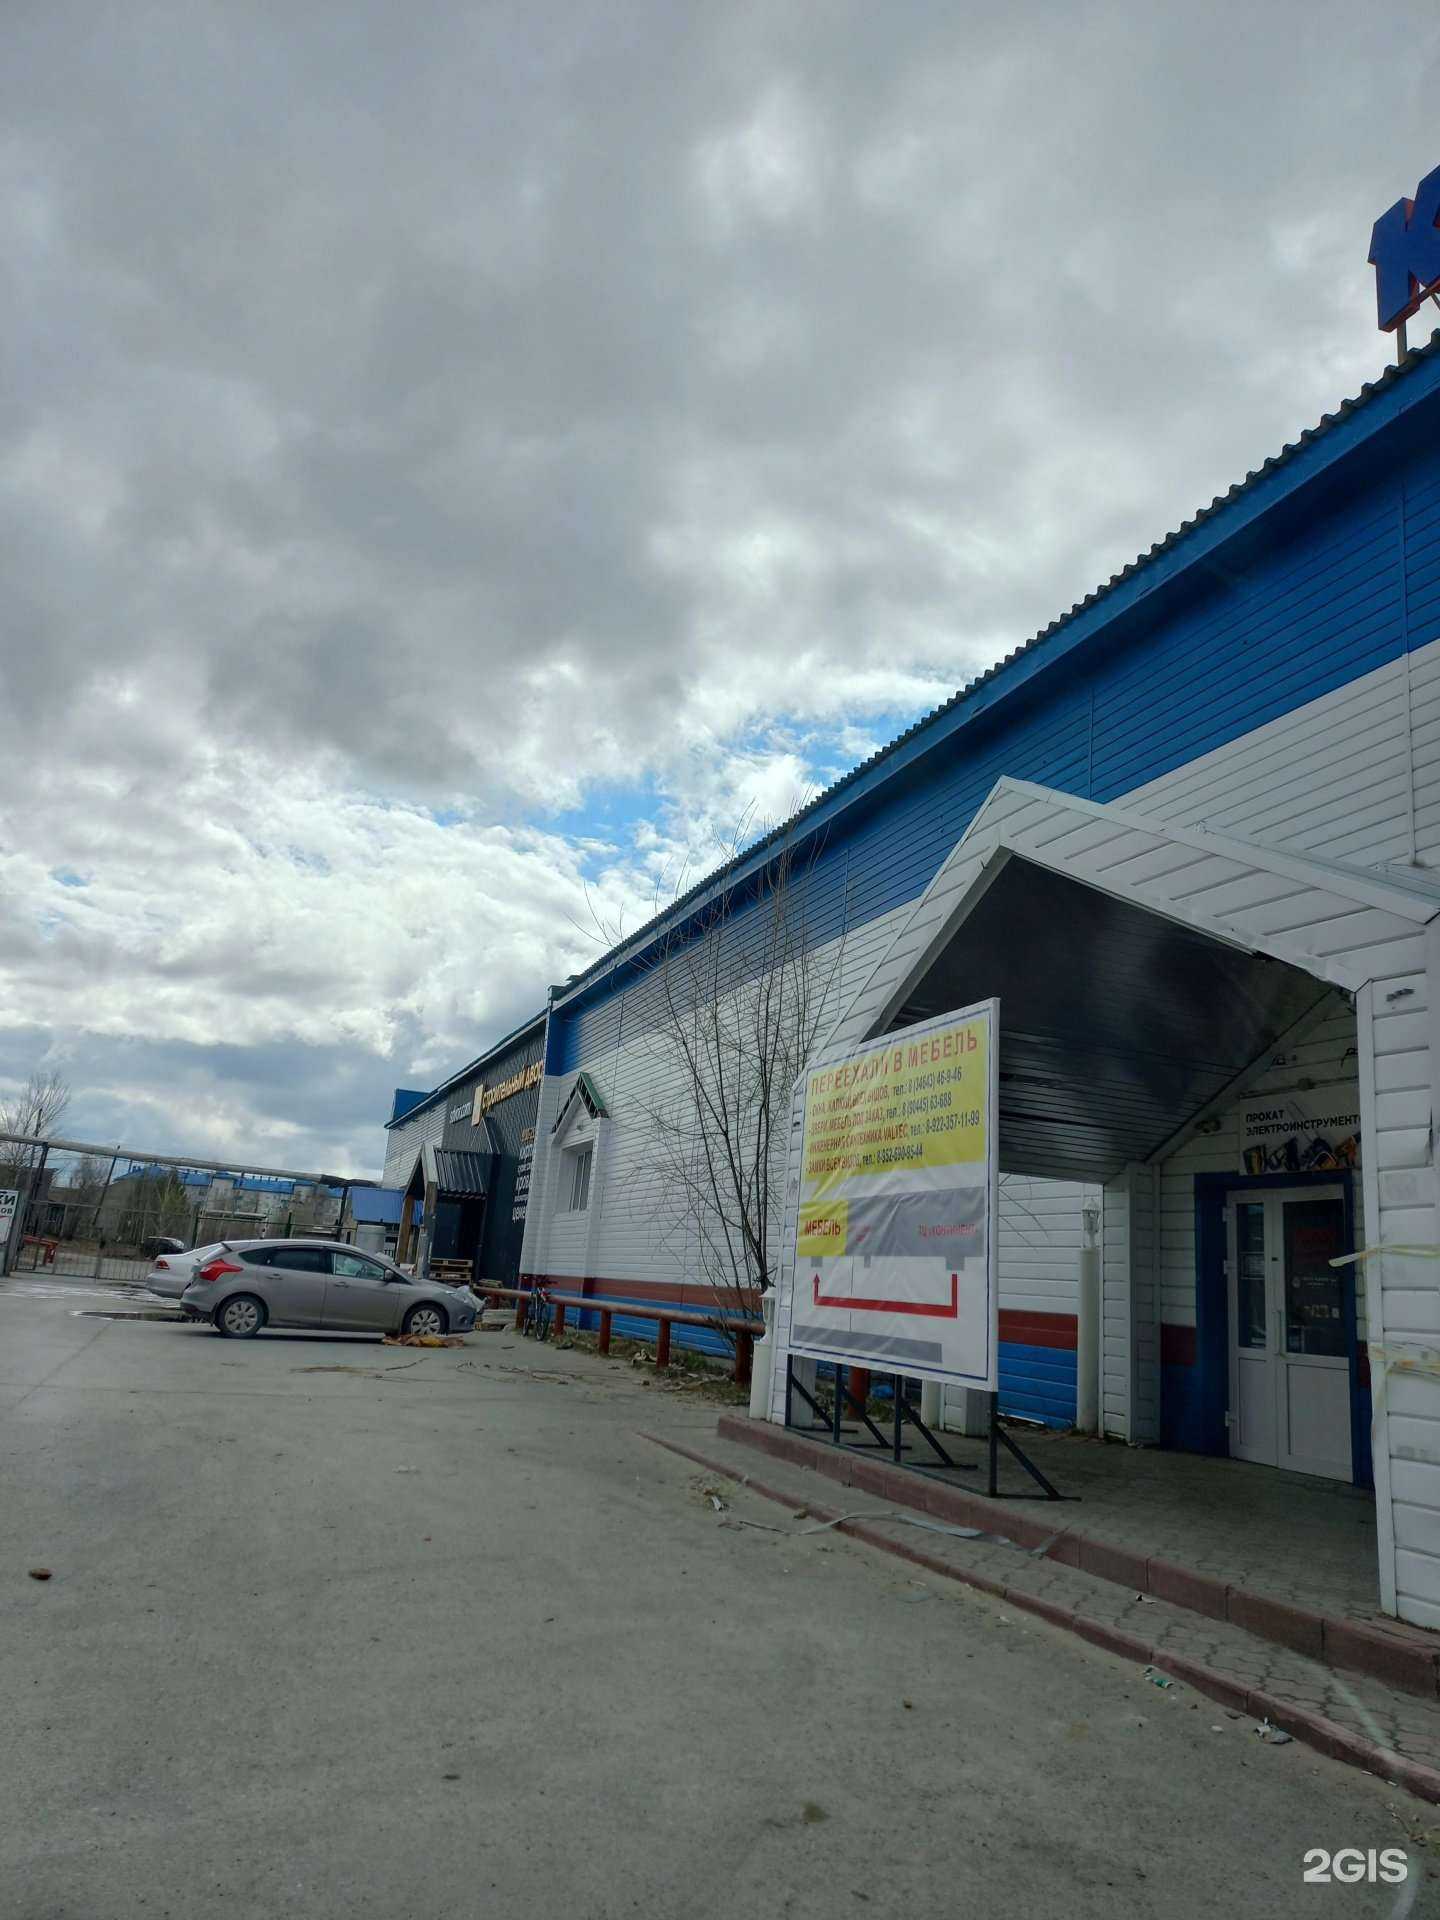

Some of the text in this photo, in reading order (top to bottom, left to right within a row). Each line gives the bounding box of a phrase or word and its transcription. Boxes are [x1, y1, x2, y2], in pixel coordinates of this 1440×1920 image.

[894, 1052, 902, 1072] В
[908, 1030, 977, 1068] МЕБЕЛЬ
[1246, 1110, 1284, 1123] ПРОКАТ
[1246, 1114, 1361, 1136] ЭЛЕКТРОИНСТРУМЕНТ
[804, 1218, 841, 1236] МЕБЕЛЬ
